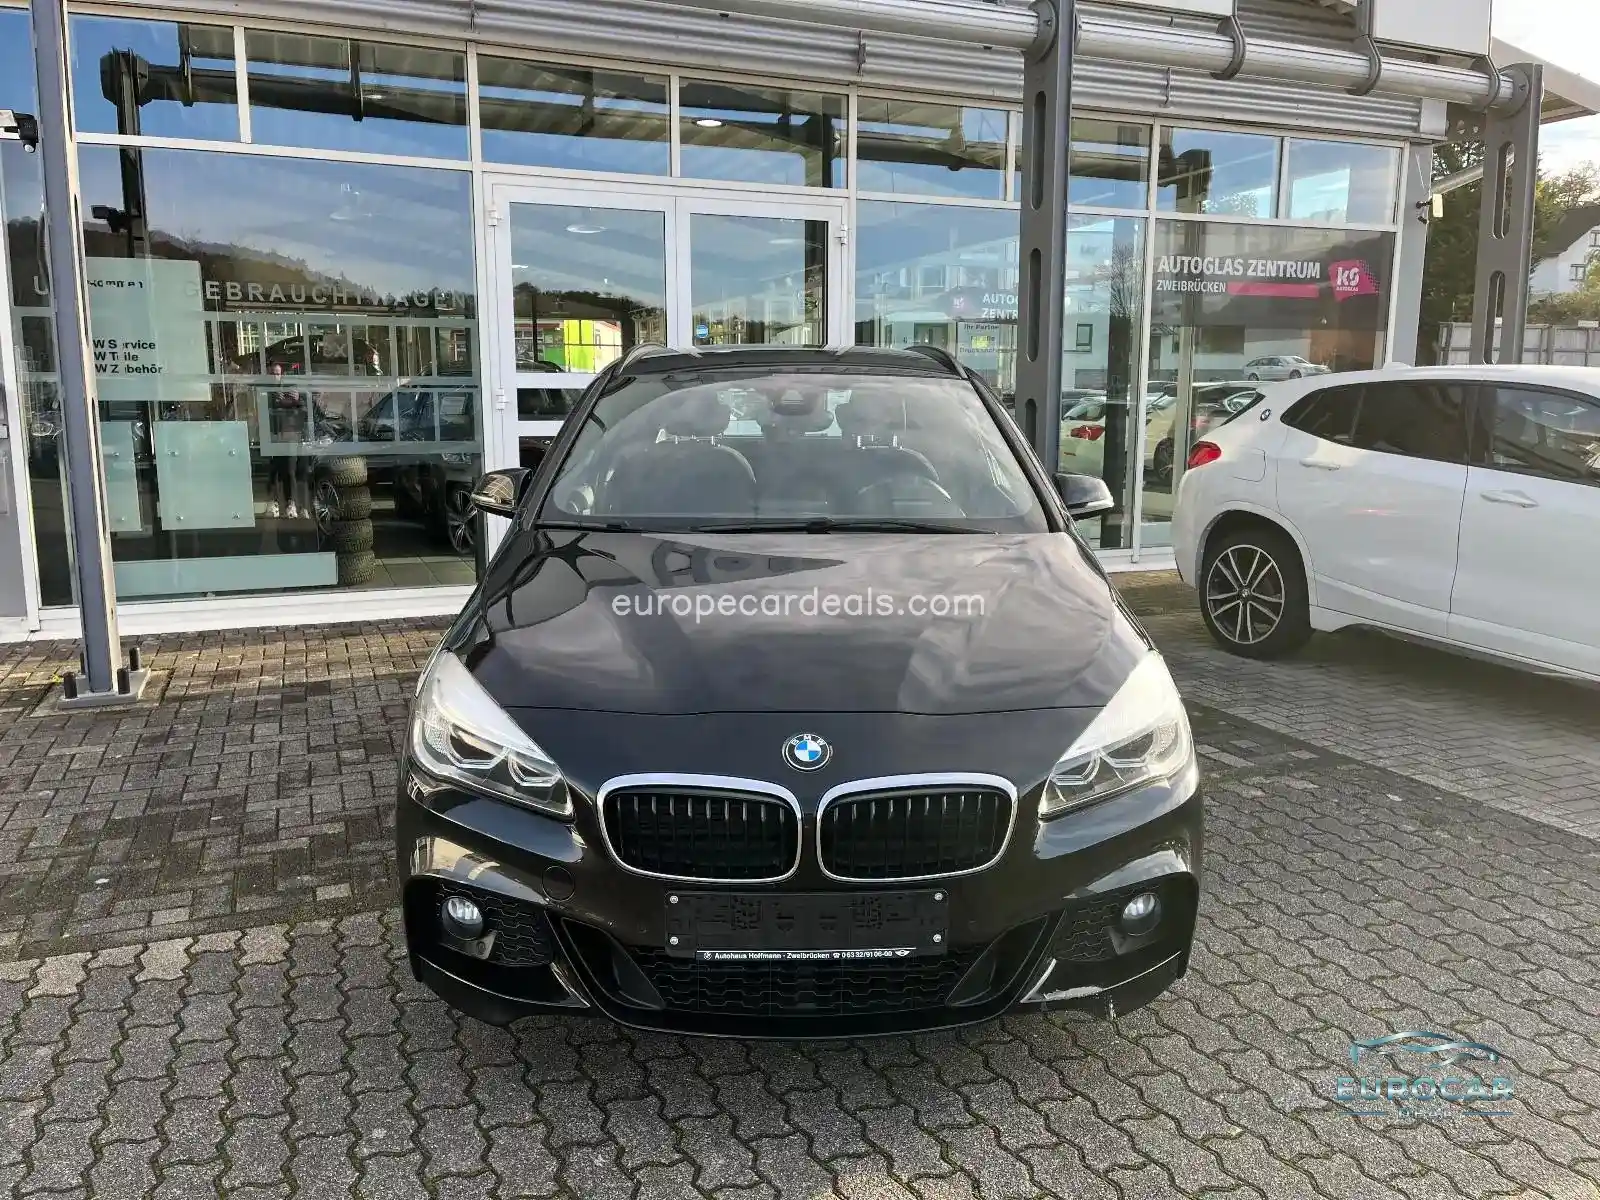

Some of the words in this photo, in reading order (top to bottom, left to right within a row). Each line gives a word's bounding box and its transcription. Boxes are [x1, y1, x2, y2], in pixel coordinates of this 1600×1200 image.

[1157, 255, 1244, 276] AUTOGLAS
[1247, 259, 1321, 279] ZENTRUM
[1156, 279, 1226, 294] ZWEIBRÜCKEN
[982, 293, 1018, 305] AUTO
[982, 308, 1018, 320] ZENTR
[108, 339, 157, 350] Srvice
[109, 351, 139, 362] Tile
[111, 364, 164, 374] Zbehör
